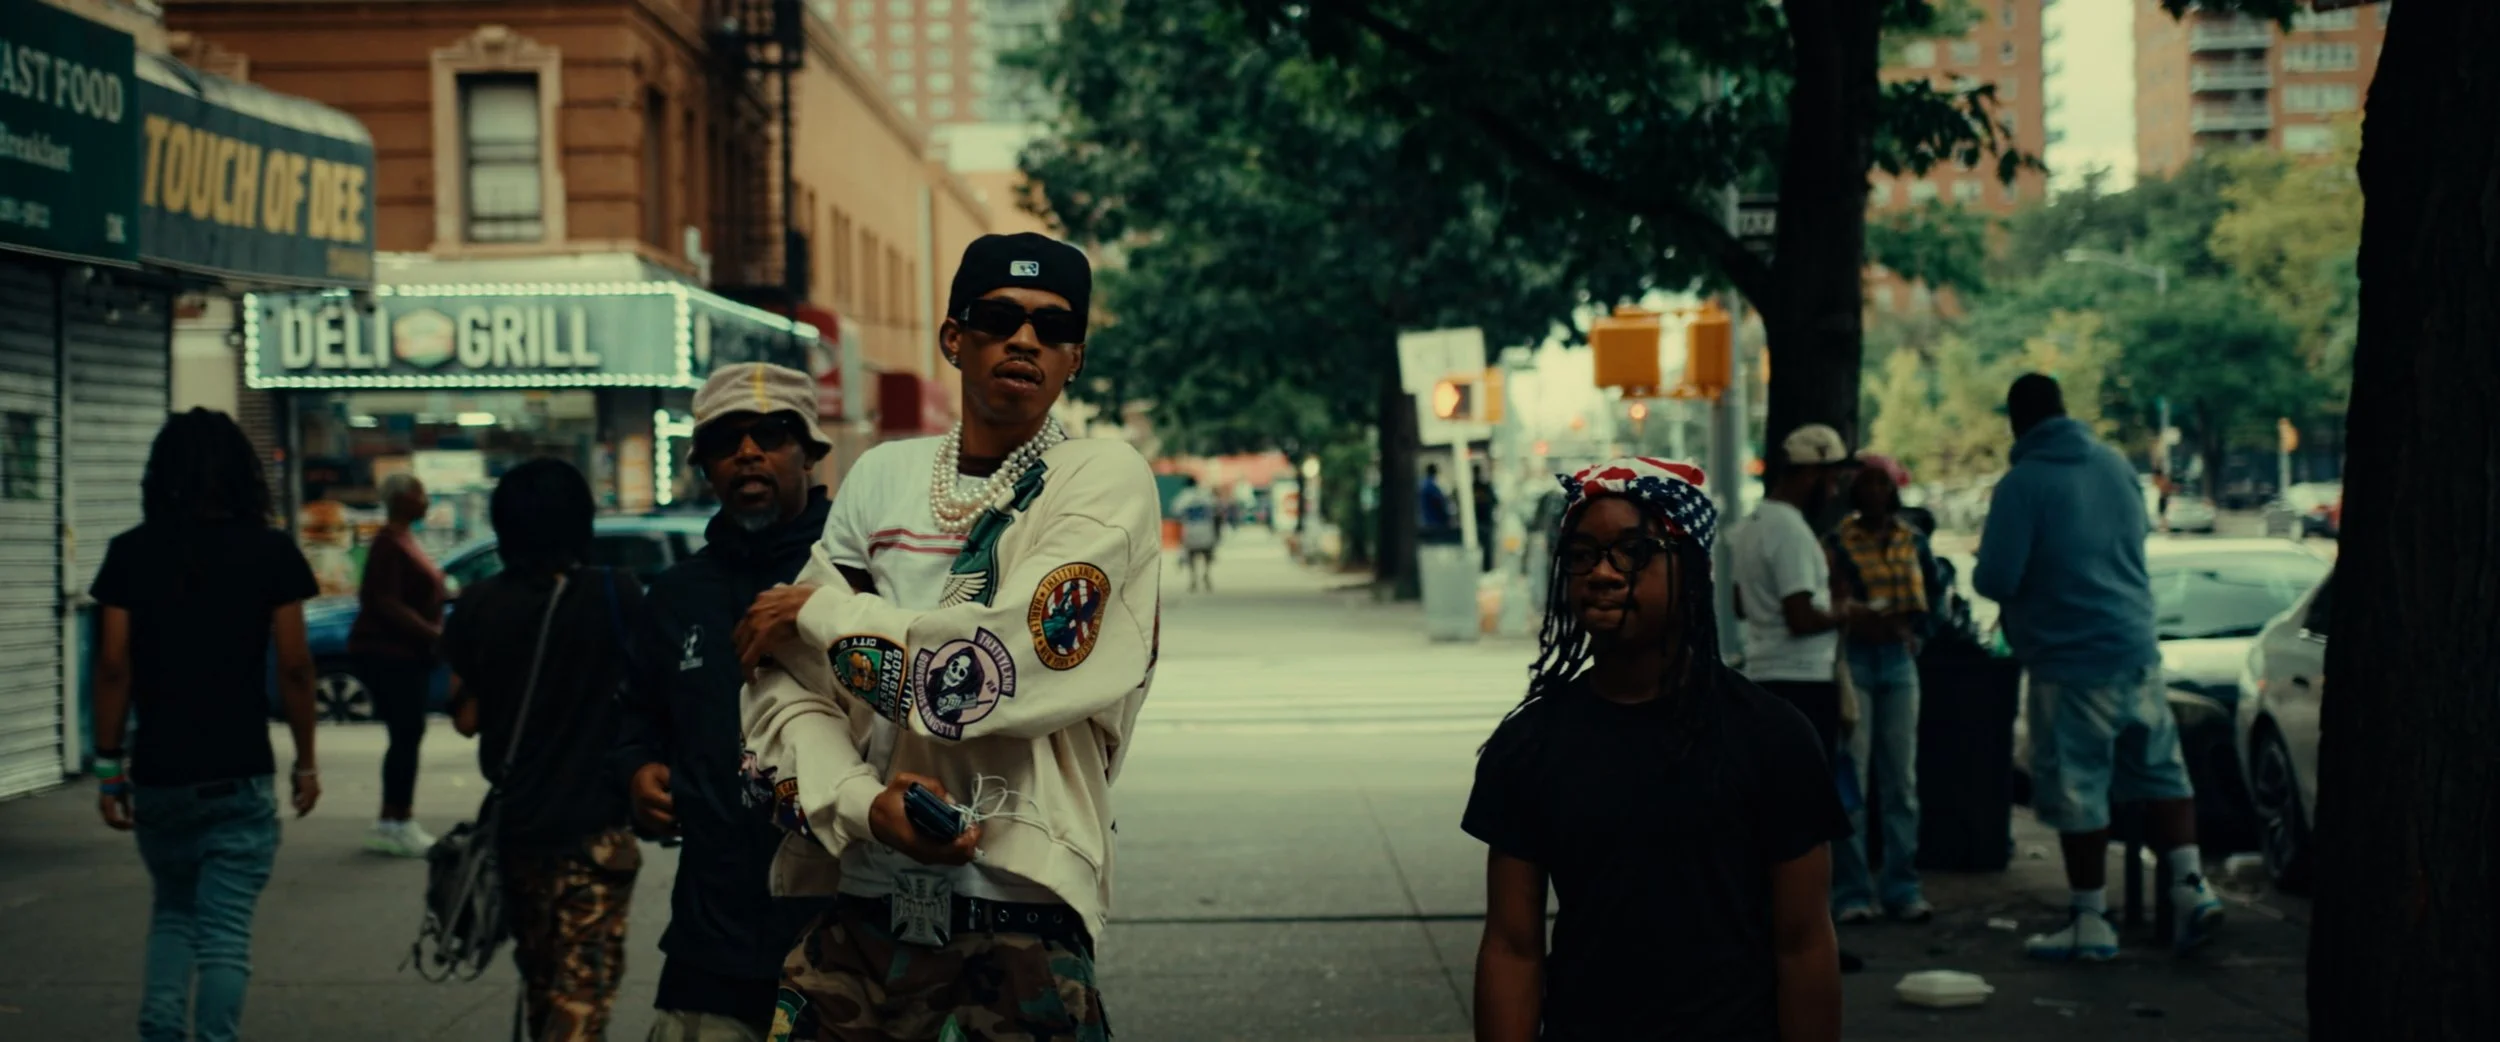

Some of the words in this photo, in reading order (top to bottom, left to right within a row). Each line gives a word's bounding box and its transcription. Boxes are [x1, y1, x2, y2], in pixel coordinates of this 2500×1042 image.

[0, 38, 50, 103] AST
[53, 56, 124, 124] FOOD
[144, 114, 261, 228] TOUCH
[262, 149, 306, 235] OF
[308, 158, 366, 243] DEE
[280, 300, 391, 370] DELI
[457, 303, 602, 369] GRILL
[851, 637, 878, 648] CITY
[1030, 598, 1043, 638] HARLEM
[915, 652, 930, 707] GORGEOUS
[921, 706, 958, 737] GANGSTA
